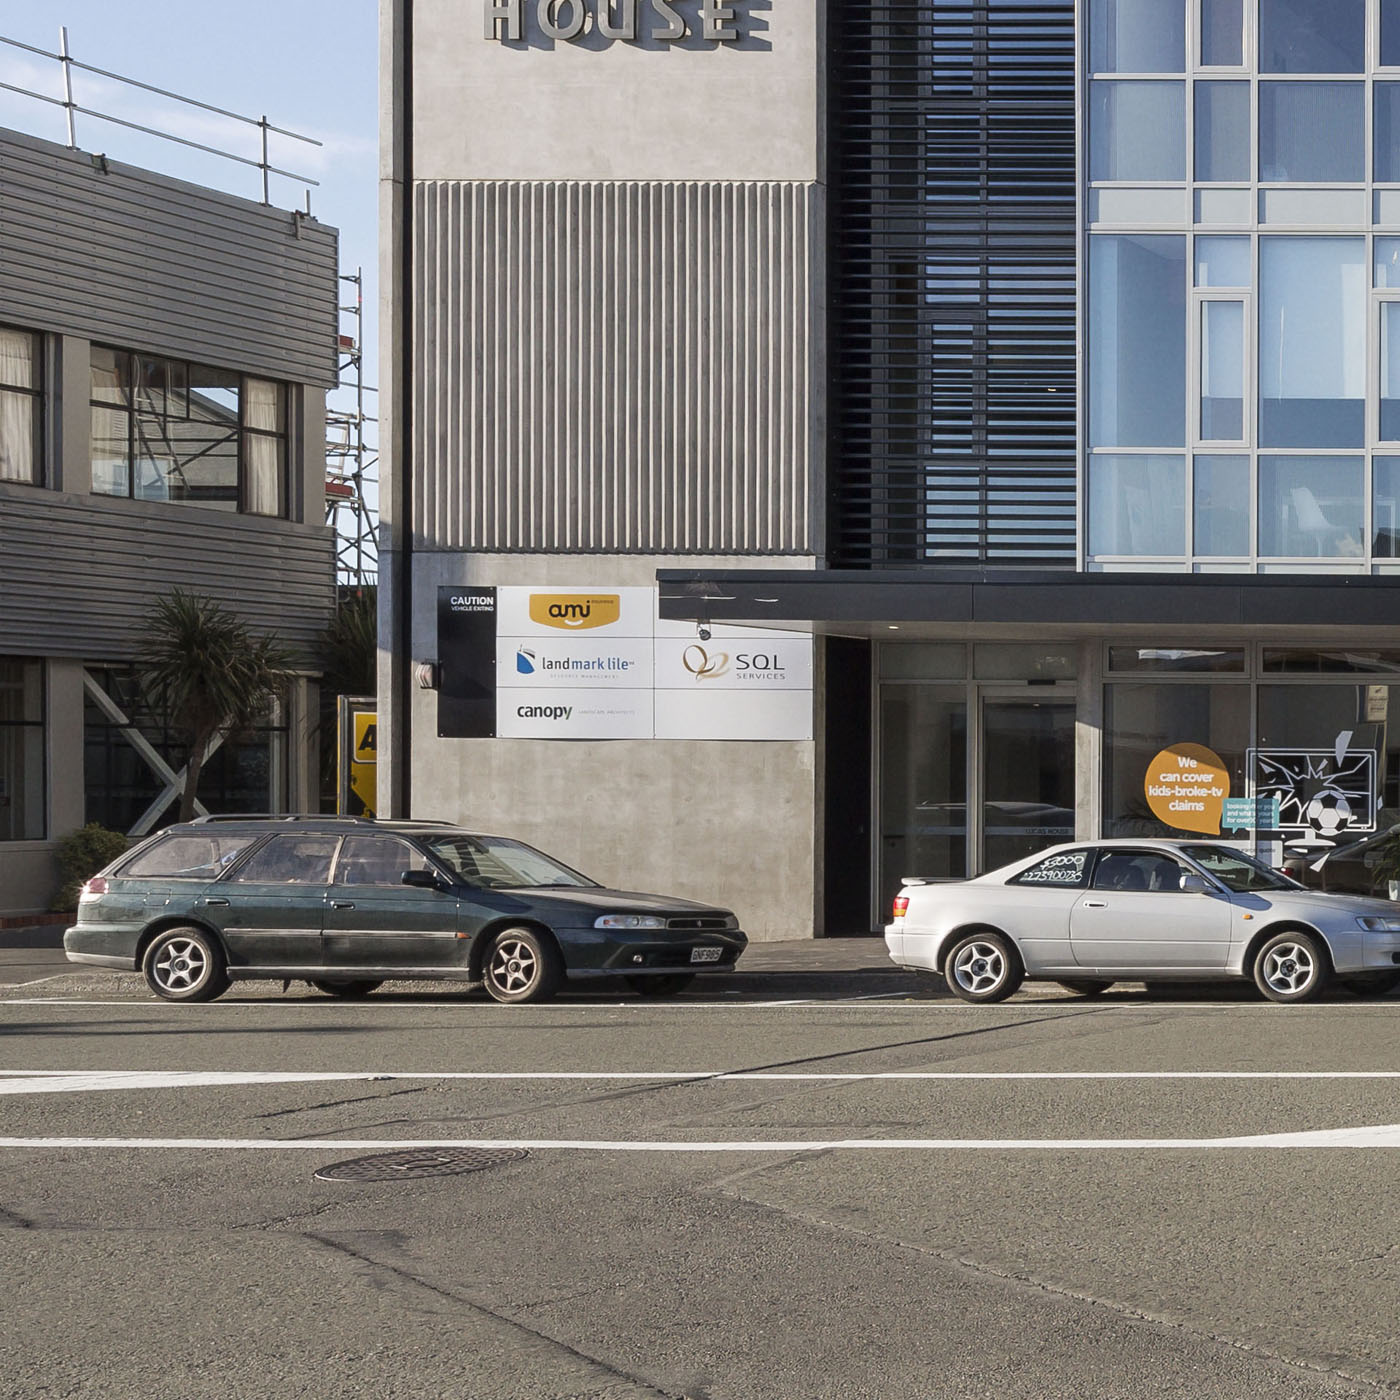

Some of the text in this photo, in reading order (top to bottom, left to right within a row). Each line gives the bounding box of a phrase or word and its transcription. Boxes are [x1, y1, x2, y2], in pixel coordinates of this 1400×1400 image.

[450, 596, 494, 605] CAUTION
[548, 600, 591, 618] ami
[541, 657, 629, 670] landmark lile
[735, 653, 786, 670] SQL
[736, 672, 786, 680] SERVICES
[516, 706, 573, 720] canopy
[1177, 756, 1198, 768] We
[1159, 773, 1215, 783] can cover
[1148, 785, 1224, 797] kids-broke-tv
[1168, 800, 1205, 811] claims
